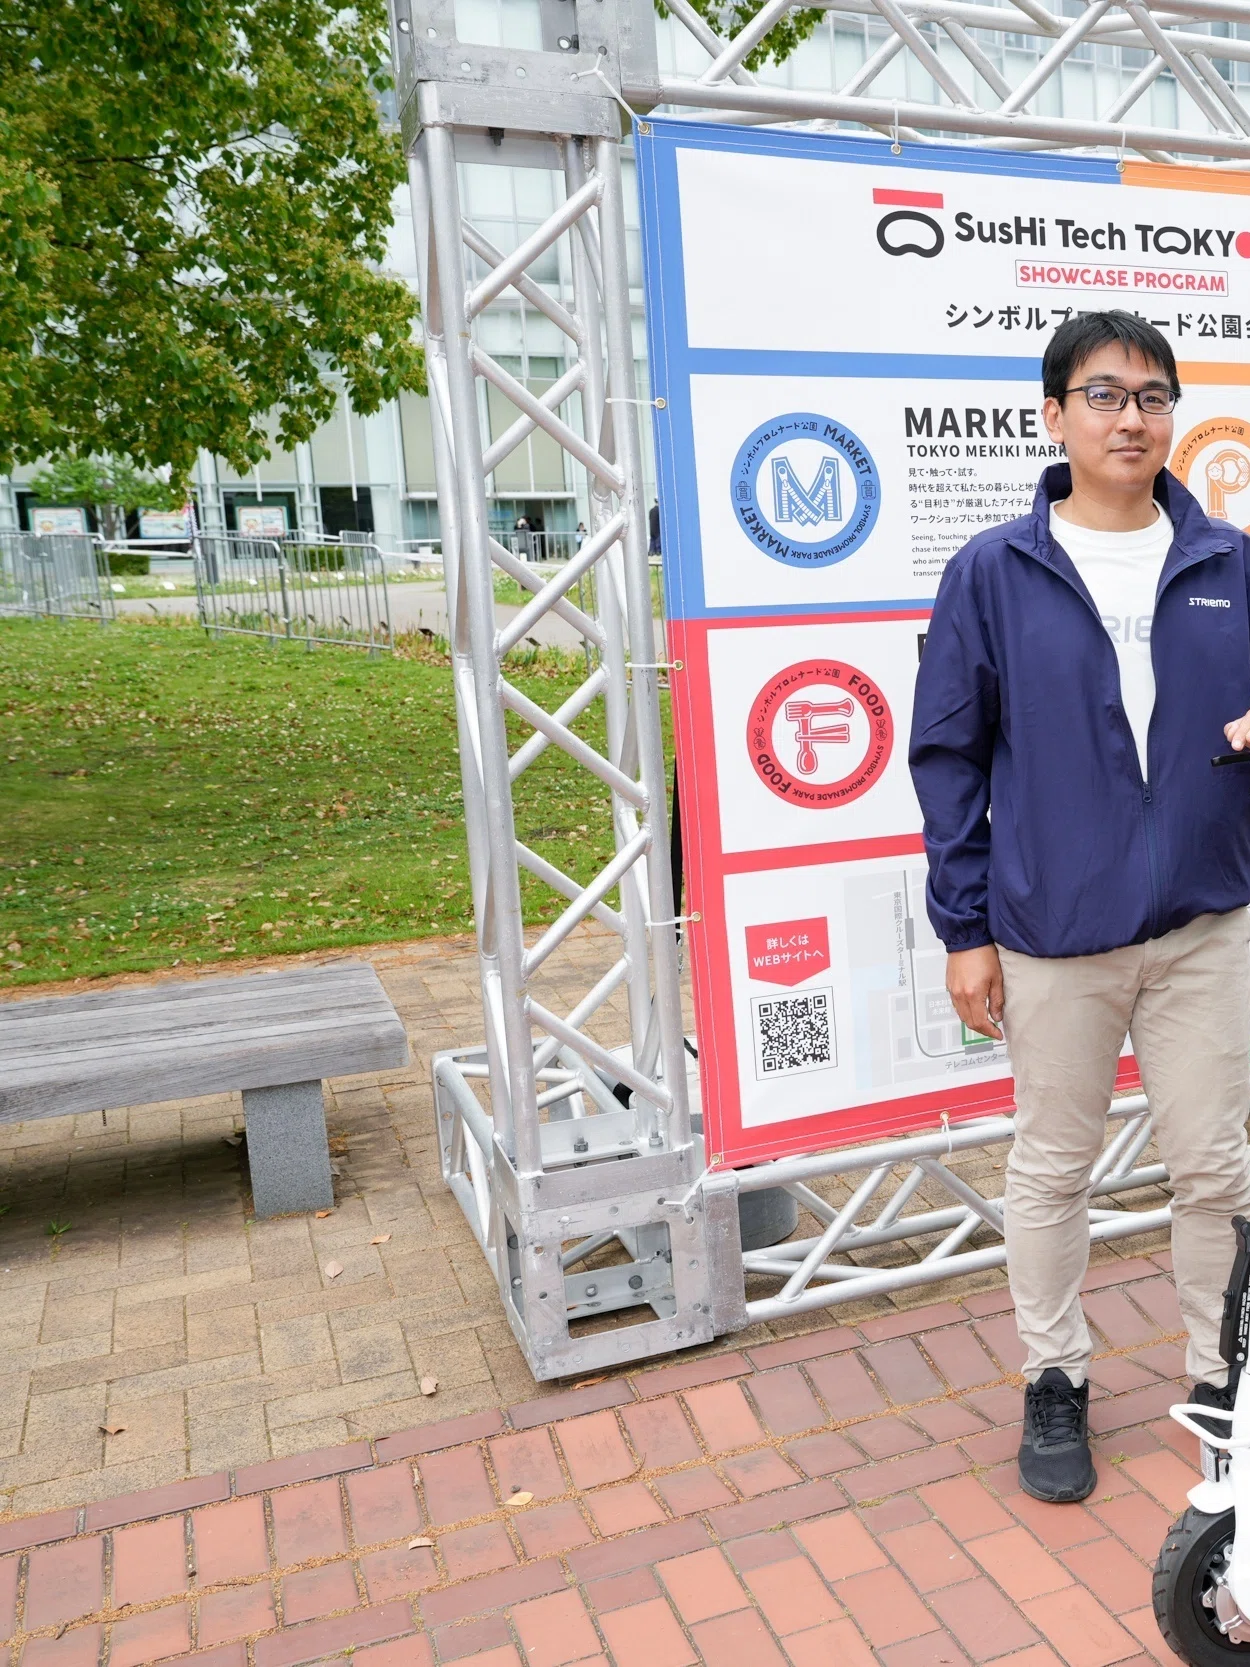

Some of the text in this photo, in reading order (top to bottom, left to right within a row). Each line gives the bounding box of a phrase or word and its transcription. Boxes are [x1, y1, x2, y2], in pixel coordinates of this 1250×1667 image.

[955, 211, 1046, 246] SusHi
[1055, 218, 1126, 251] Tech
[1020, 265, 1226, 292] SHOWCASE PROGRAM
[904, 407, 1043, 438] MARKE
[823, 424, 872, 475] MARKET
[907, 444, 1068, 458] TOKYO MEKIKI MARK
[910, 497, 1033, 509] る“目利き”が厳選したアイテム
[739, 507, 790, 558] MARKET
[911, 534, 936, 542] Seeing,
[937, 533, 968, 541] Touching
[848, 674, 885, 717] FOOD
[757, 753, 792, 793] FOOD
[765, 934, 809, 950] 詳しくは
[753, 949, 824, 967] WEBサイトへ
[945, 1053, 1008, 1070] テレコムセンター
